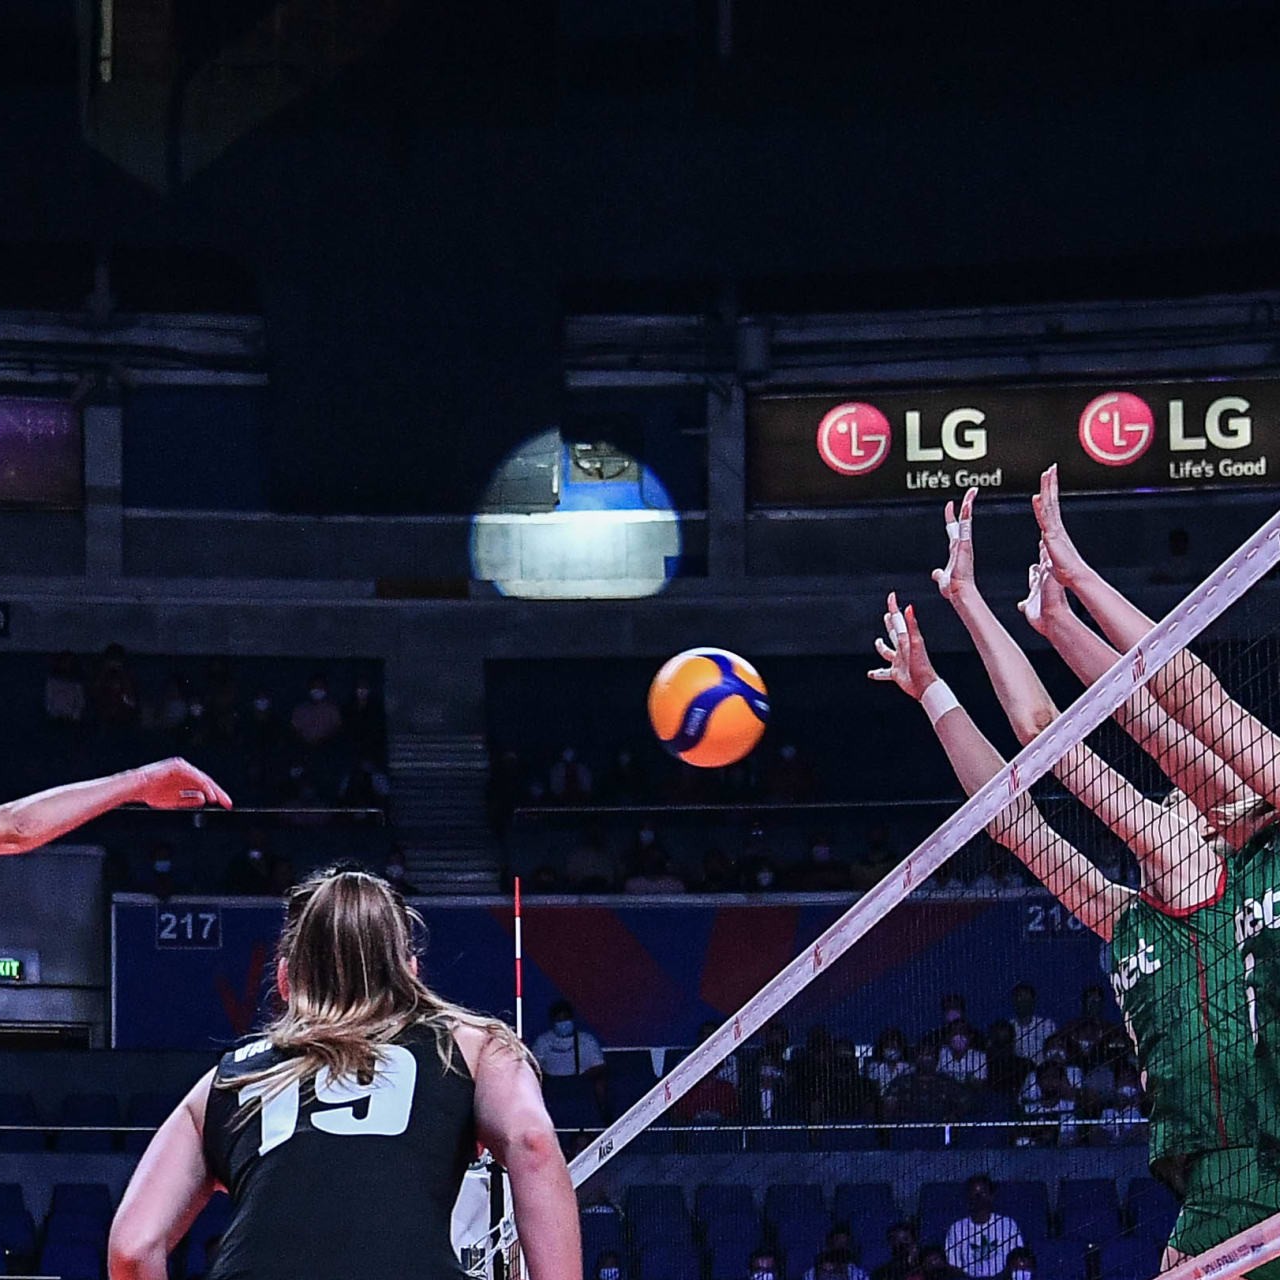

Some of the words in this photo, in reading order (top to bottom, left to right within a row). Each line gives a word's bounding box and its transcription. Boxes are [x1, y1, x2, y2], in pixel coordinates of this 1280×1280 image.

[905, 407, 989, 462] LG
[1169, 396, 1253, 451] LG
[906, 470, 952, 489] Life's
[955, 468, 1003, 488] Good
[1169, 459, 1215, 479] Life's
[1219, 456, 1267, 477] Good
[160, 912, 217, 940] 217
[238, 1043, 417, 1157] 19
